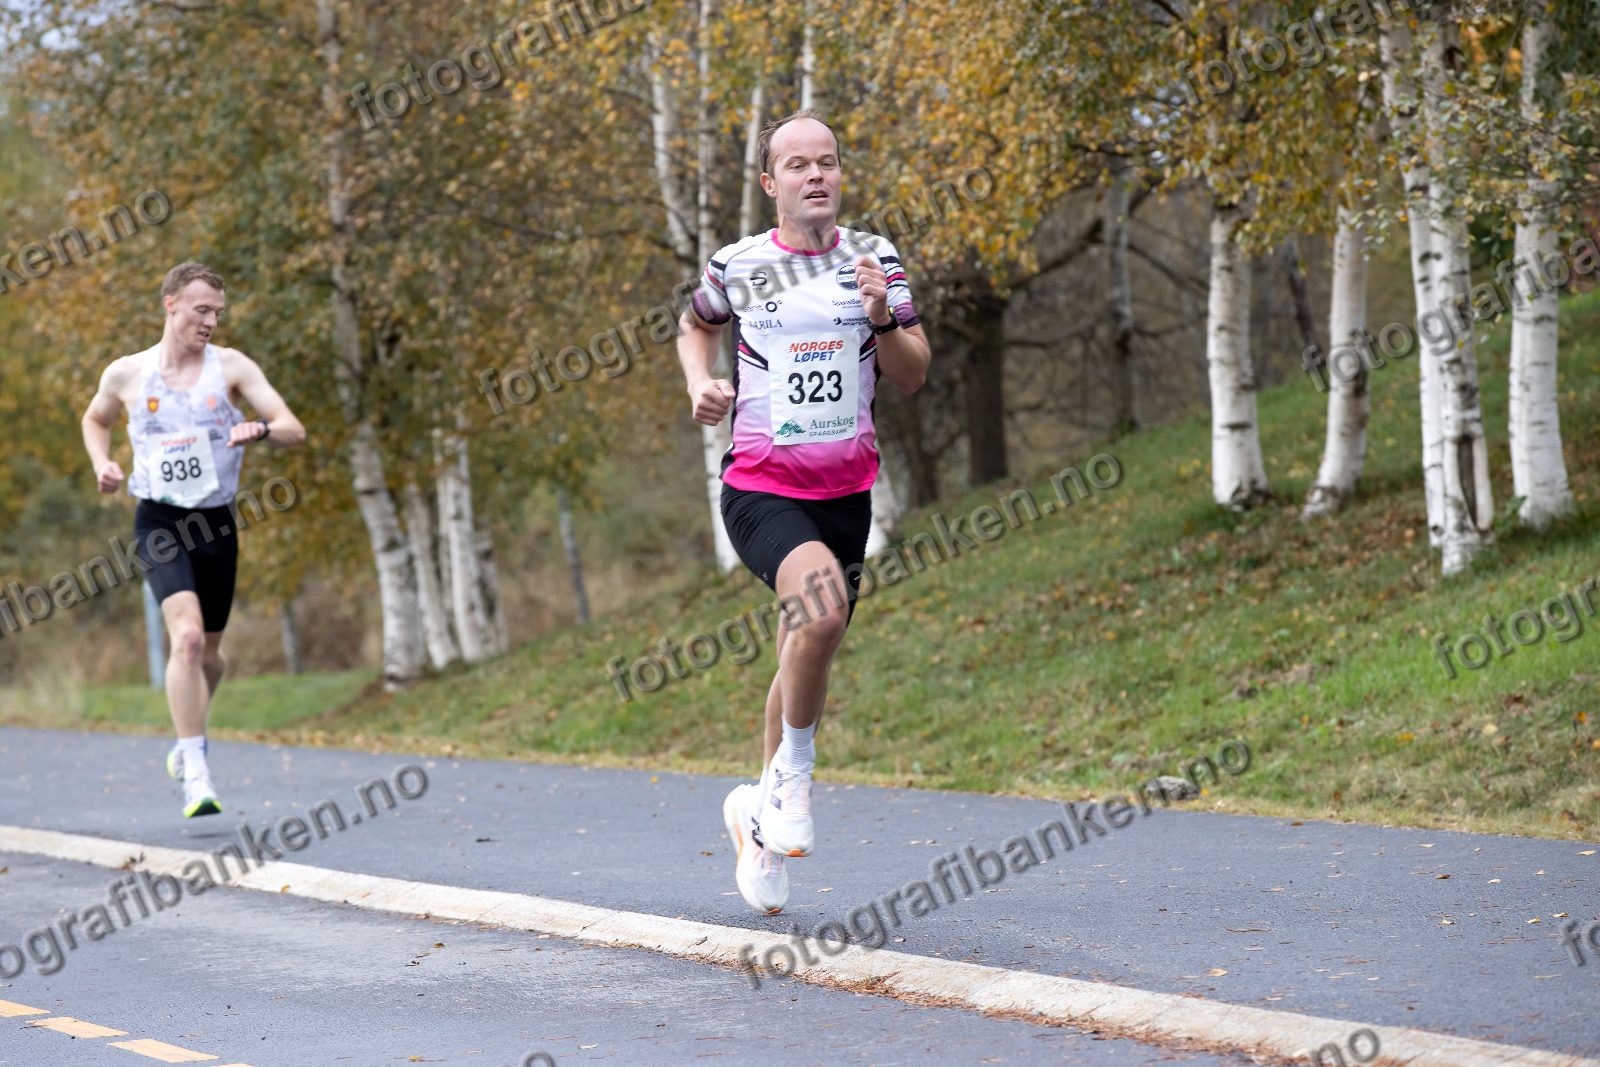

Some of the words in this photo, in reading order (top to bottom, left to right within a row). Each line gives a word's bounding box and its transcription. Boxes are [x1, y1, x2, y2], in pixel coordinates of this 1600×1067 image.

[788, 340, 844, 353] NORGES
[794, 350, 836, 363] LØPET
[787, 370, 843, 405] 323
[809, 416, 855, 430] Aurskog
[160, 457, 202, 482] 938
